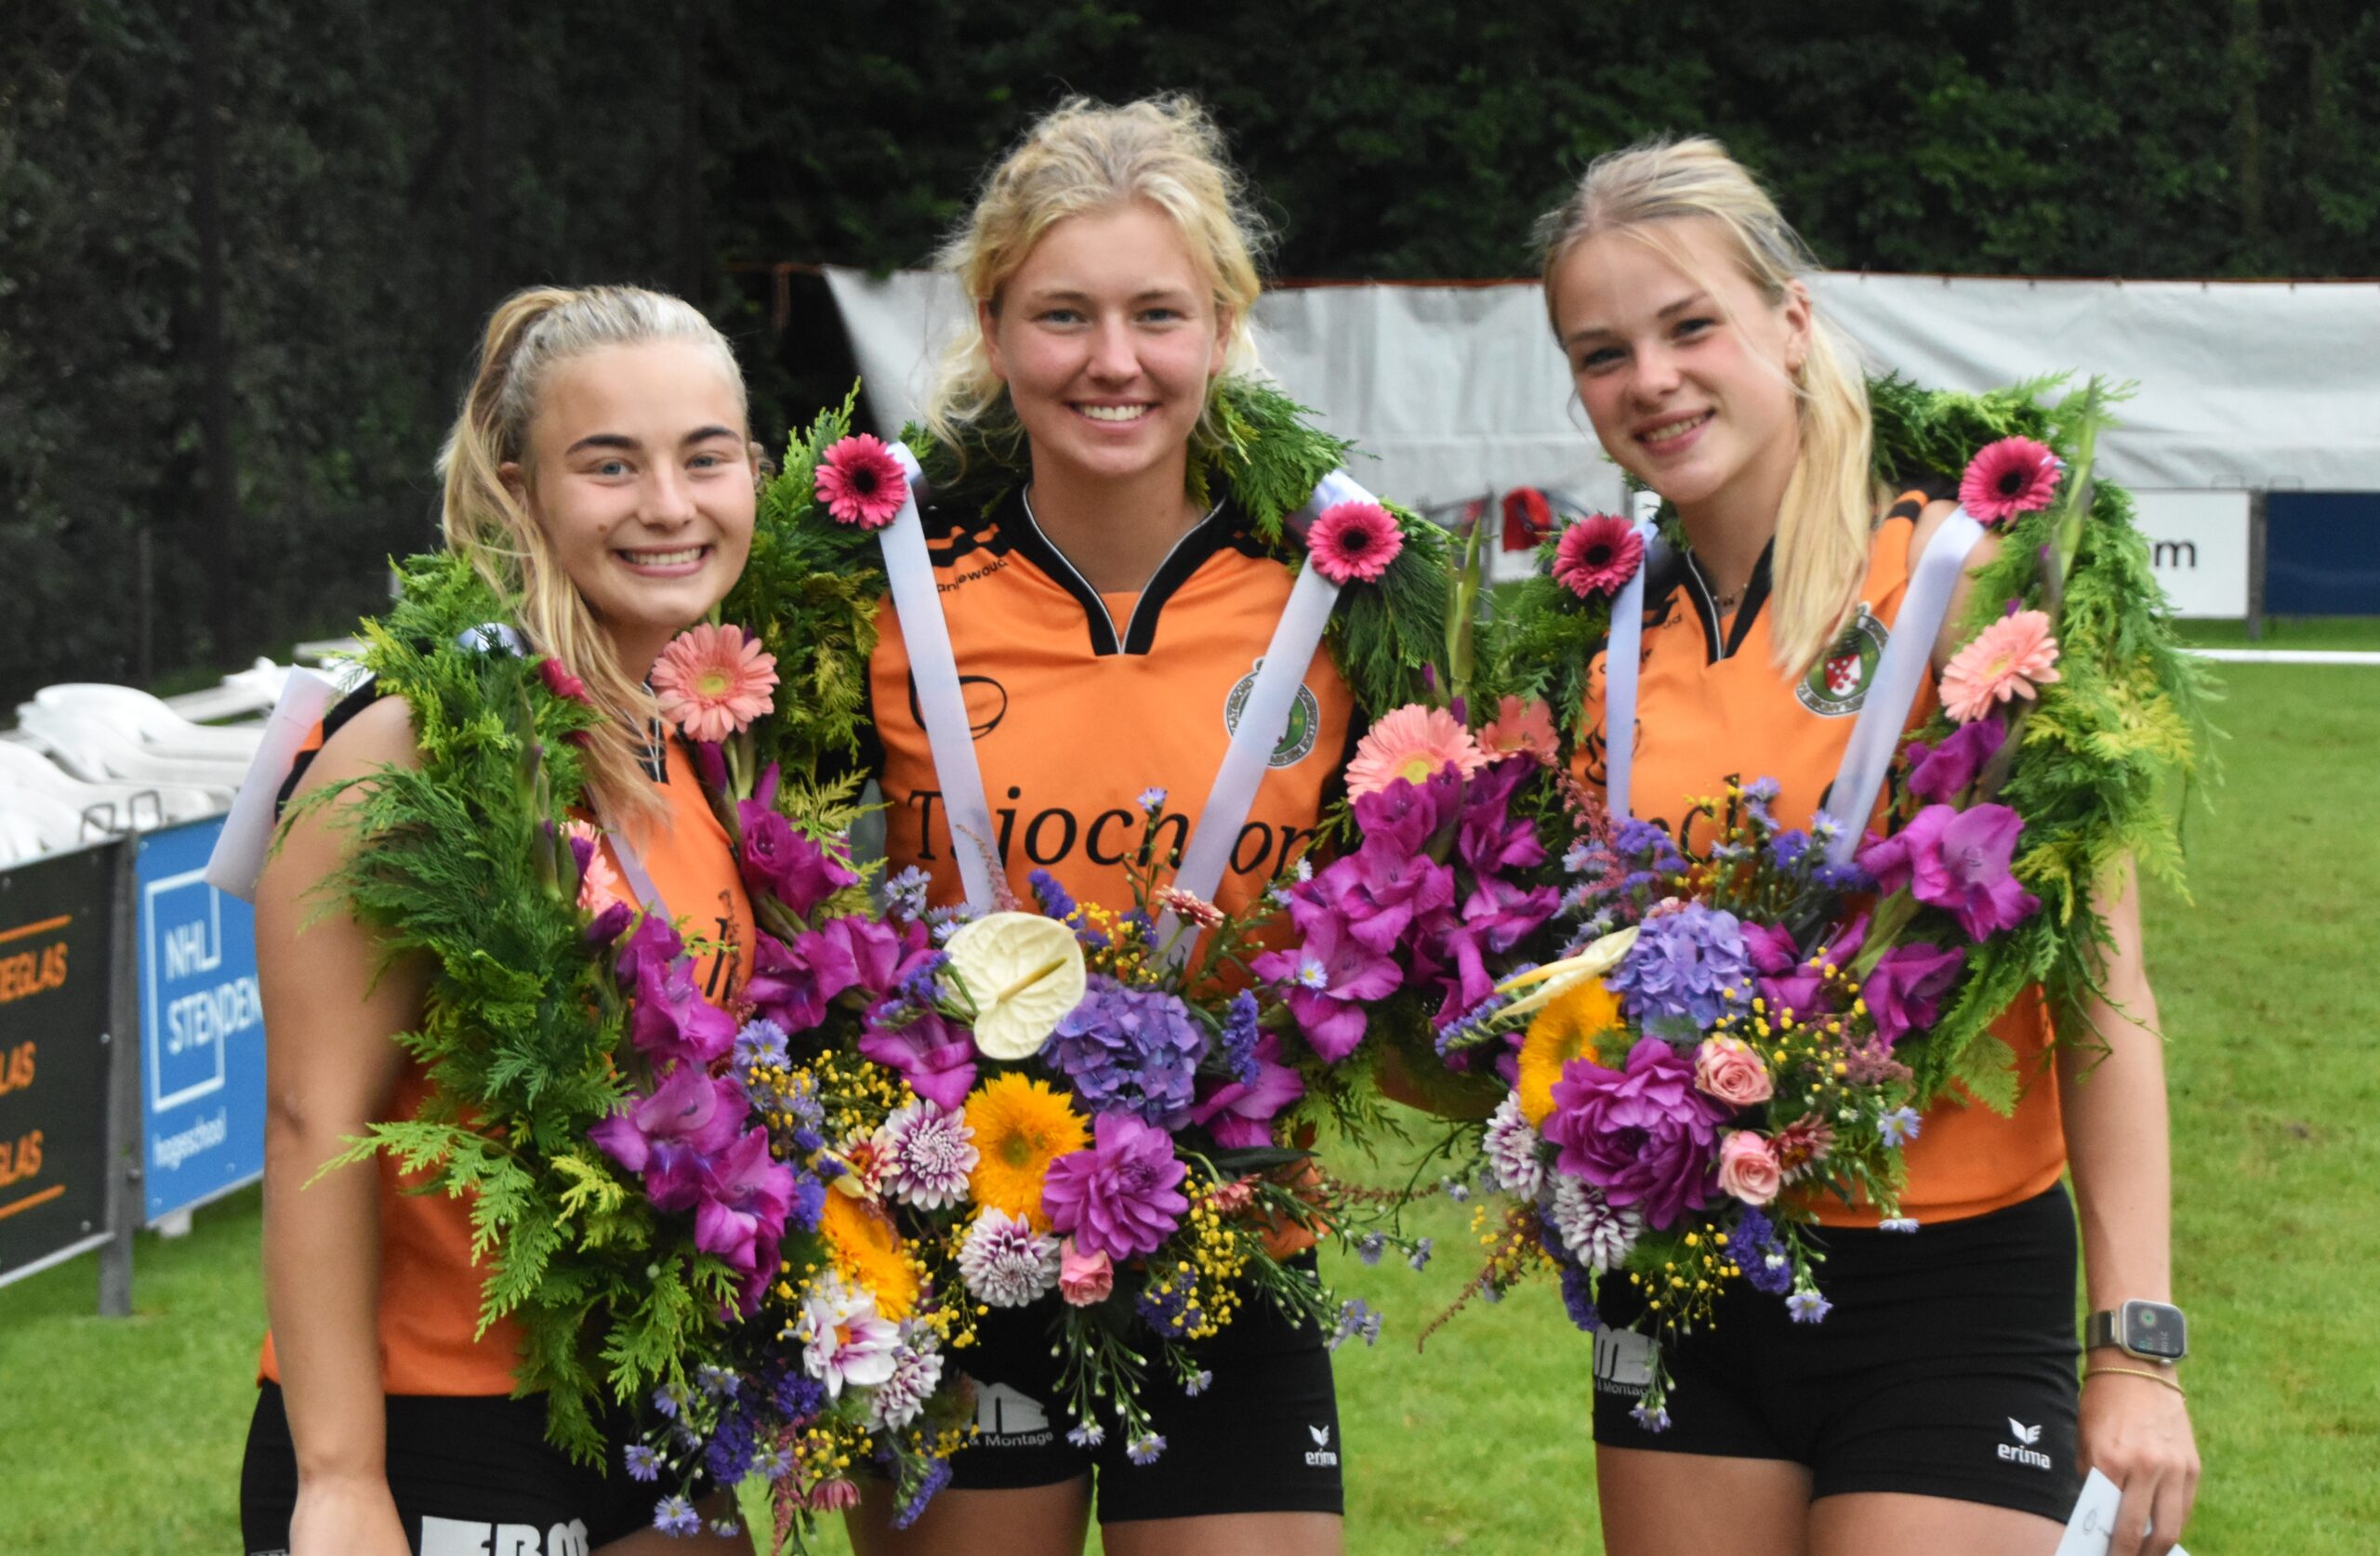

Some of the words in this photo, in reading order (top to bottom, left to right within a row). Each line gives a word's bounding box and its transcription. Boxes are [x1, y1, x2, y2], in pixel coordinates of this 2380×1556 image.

[2149, 540, 2196, 567] m
[906, 785, 1190, 875] Tjoch
[165, 919, 221, 982] NHL
[985, 1431, 1053, 1447] Montage
[1996, 1443, 2051, 1469] erima
